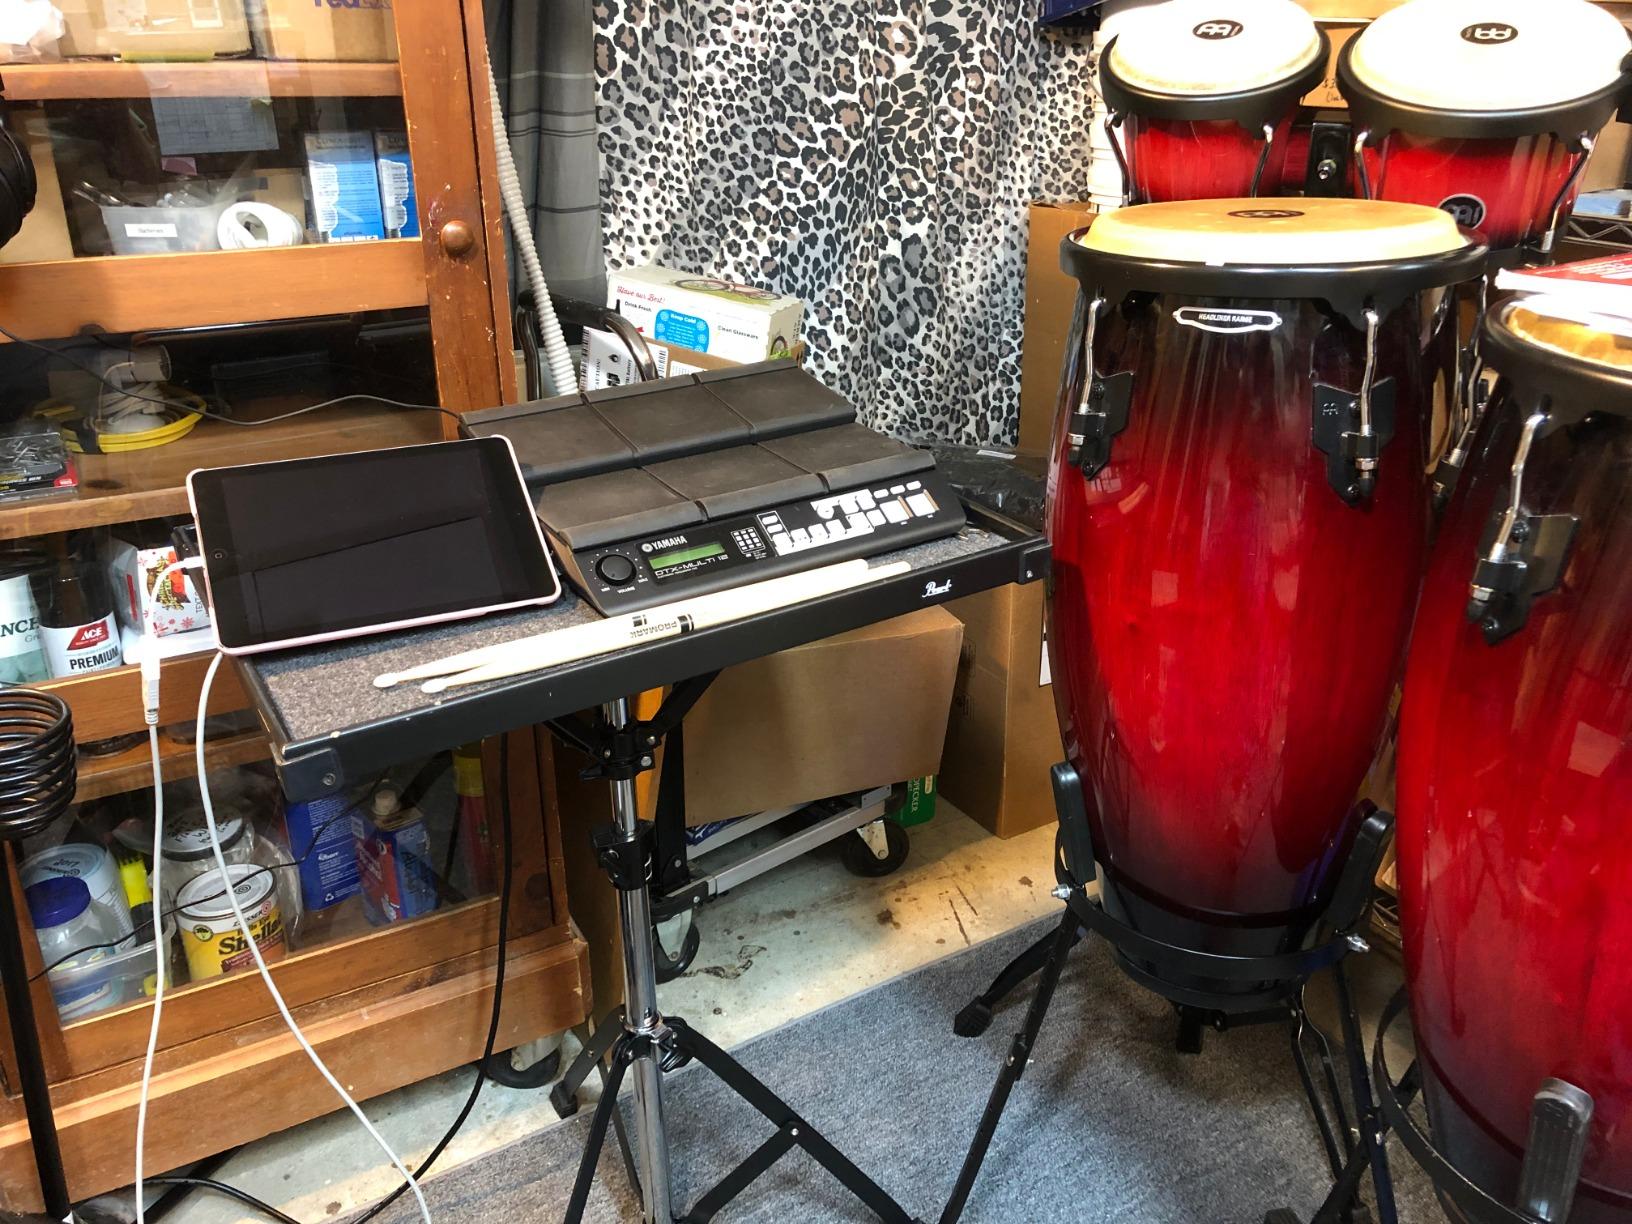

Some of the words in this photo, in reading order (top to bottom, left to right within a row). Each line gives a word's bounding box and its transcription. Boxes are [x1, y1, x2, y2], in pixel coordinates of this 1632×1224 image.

[624, 301, 638, 310] Drink
[1198, 313, 1231, 322] HEADLINER
[1231, 315, 1253, 323] RANGE
[717, 325, 733, 333] Clean
[652, 536, 687, 550] YAMAHA
[921, 579, 953, 598] Pearl
[81, 626, 103, 641] ACE
[630, 621, 677, 638] PROMARK
[69, 646, 119, 670] PREMIUM
